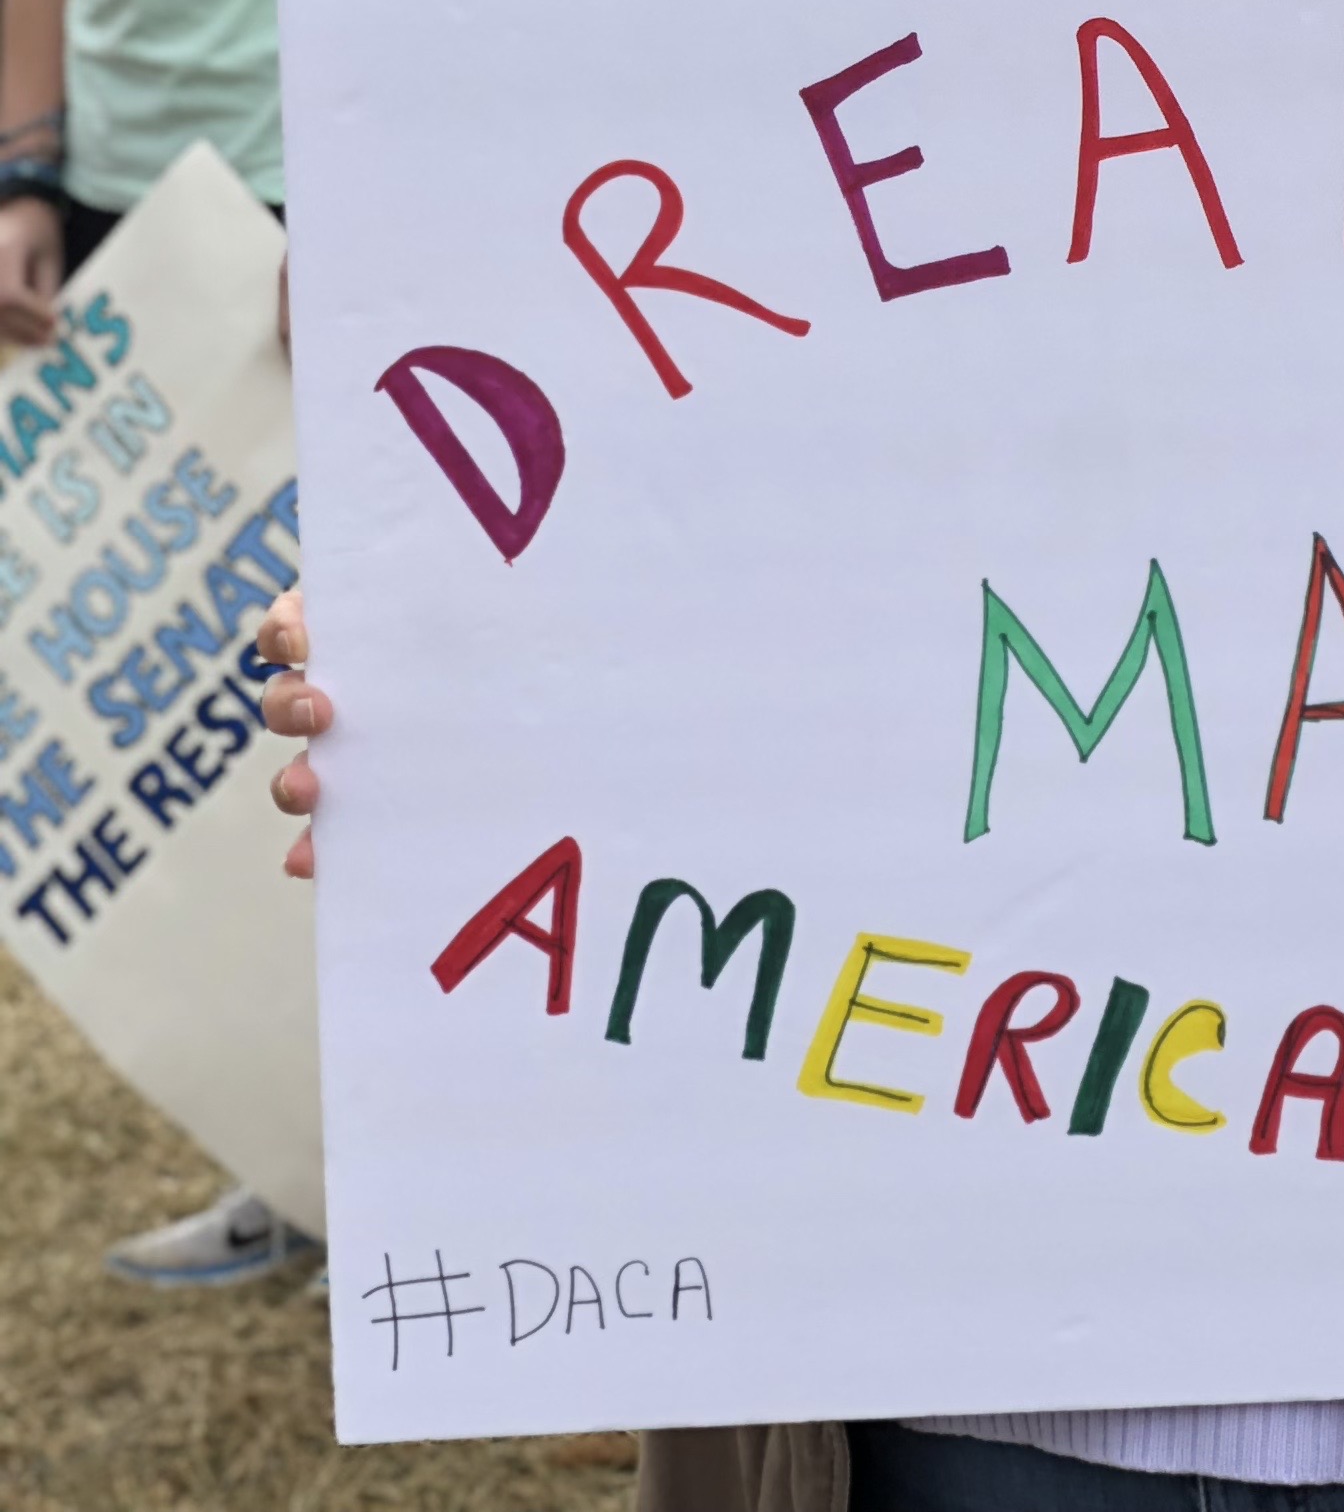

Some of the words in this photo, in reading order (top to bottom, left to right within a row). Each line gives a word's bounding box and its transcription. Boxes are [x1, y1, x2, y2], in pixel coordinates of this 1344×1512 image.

[27, 449, 101, 545] IS
[87, 372, 172, 478] IN
[28, 445, 240, 685] HOUSE
[16, 806, 149, 945] THE
[361, 1248, 714, 1372] #DACA
